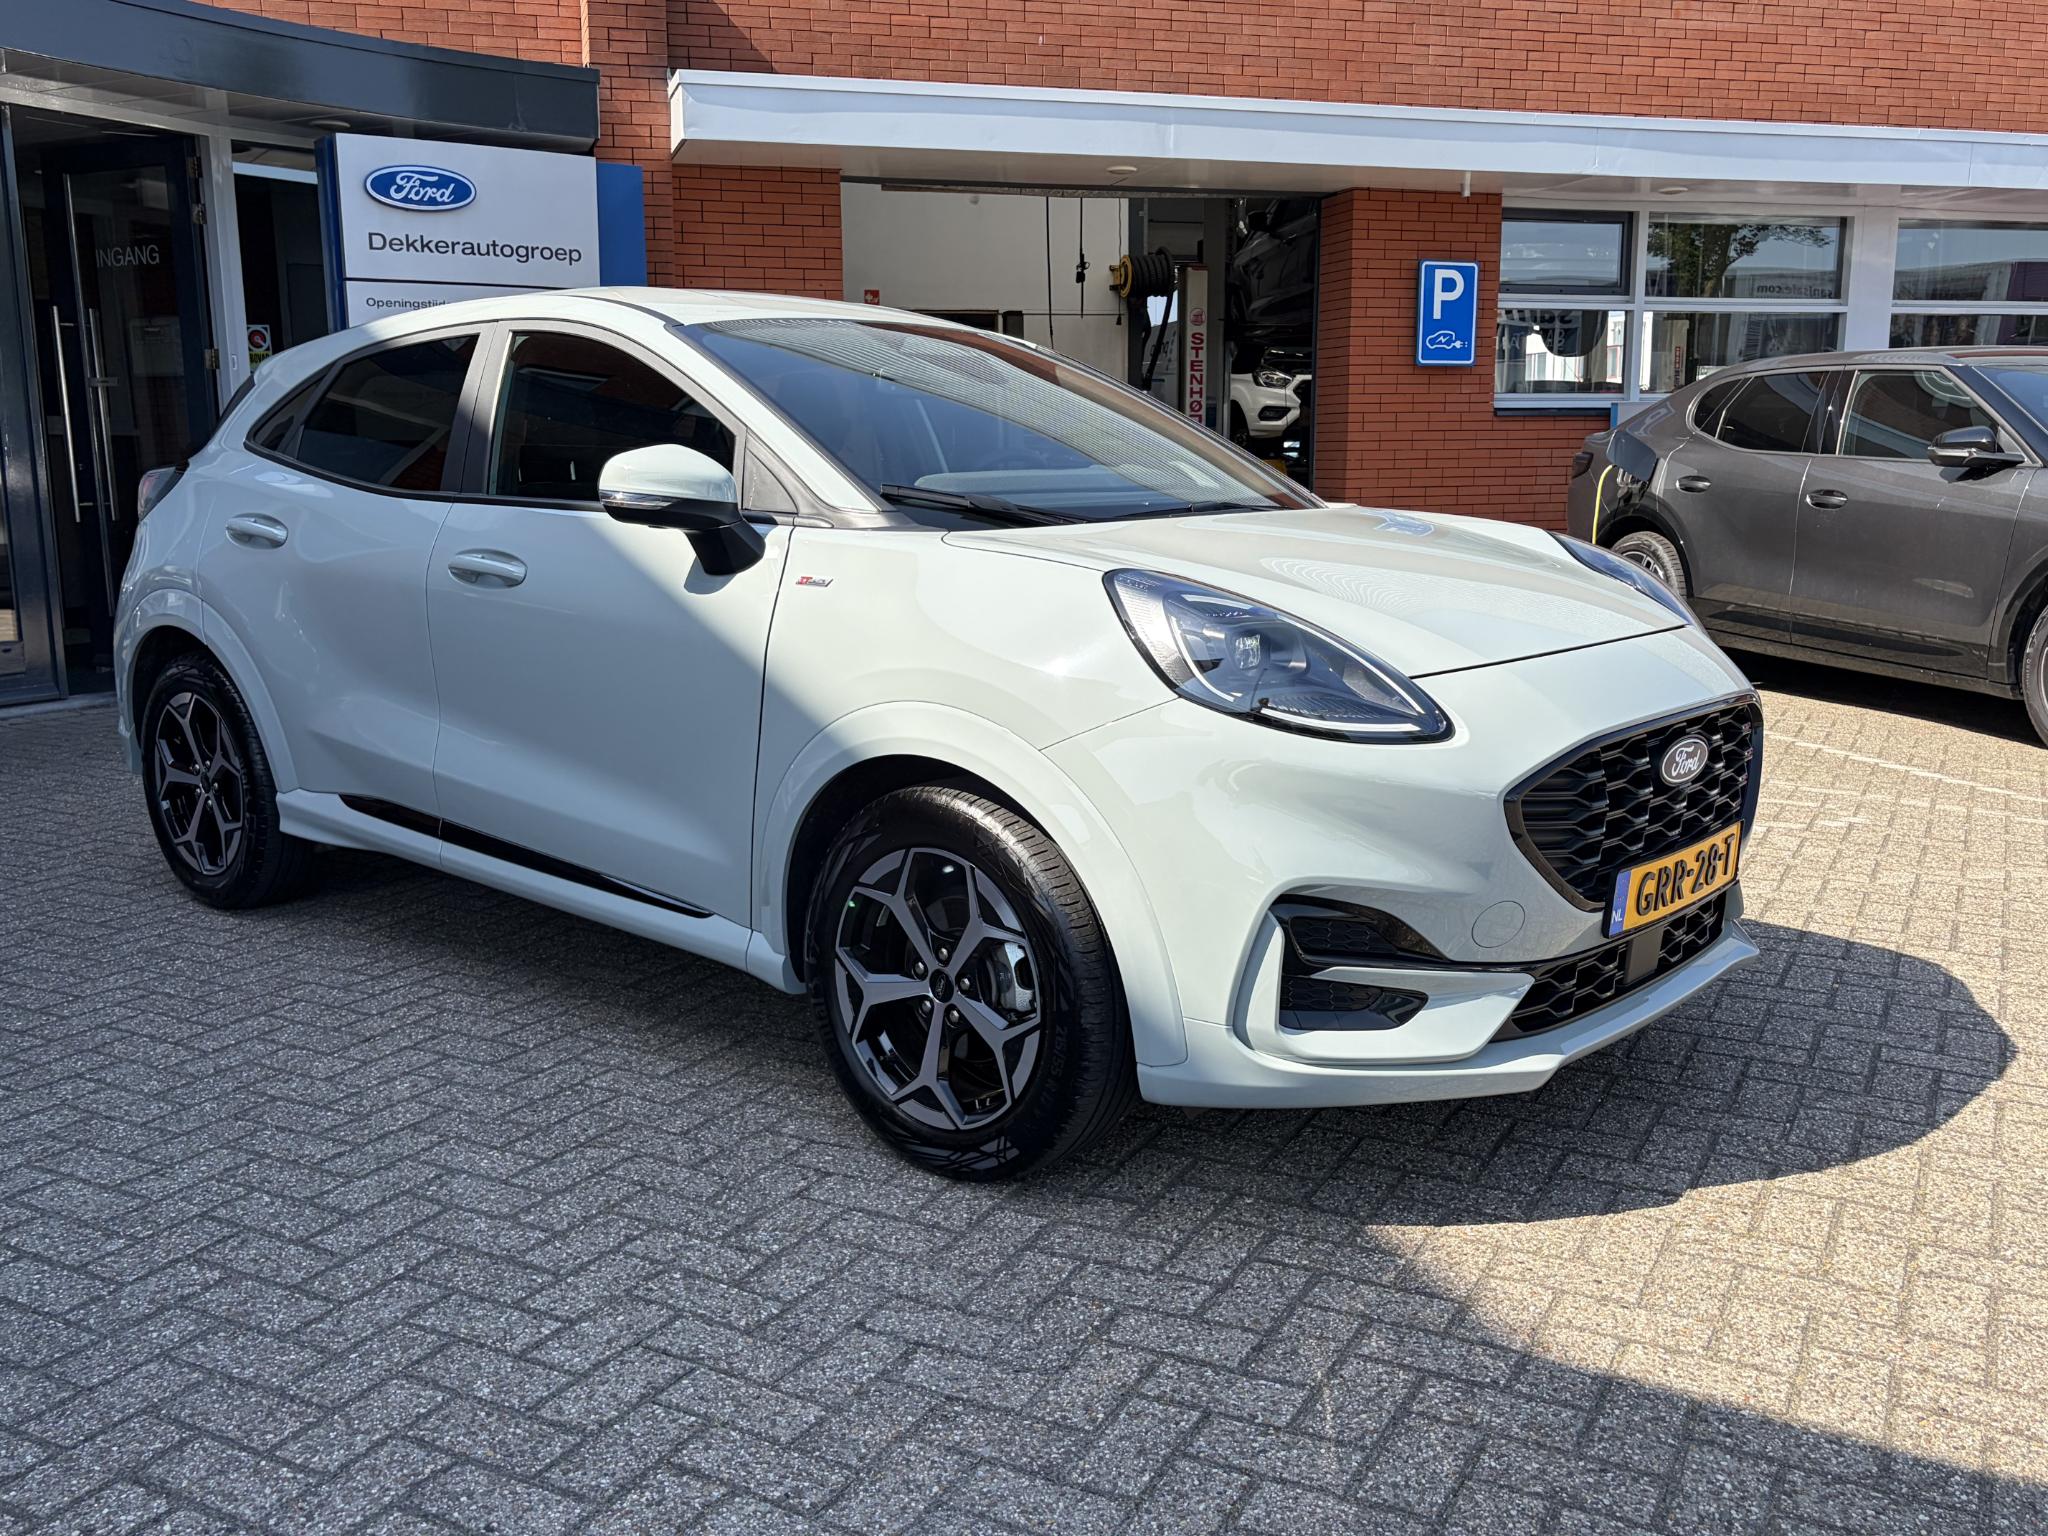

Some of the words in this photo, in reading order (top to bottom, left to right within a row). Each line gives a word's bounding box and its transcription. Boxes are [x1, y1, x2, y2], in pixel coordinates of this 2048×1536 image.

[389, 172, 454, 203] Ford
[95, 244, 160, 269] INGANG
[368, 231, 582, 266] Dekkerautogroep
[1433, 268, 1465, 320] P
[1671, 745, 1701, 777] Ford
[1636, 833, 1736, 917] GRR-28-T
[1611, 907, 1623, 924] NL
